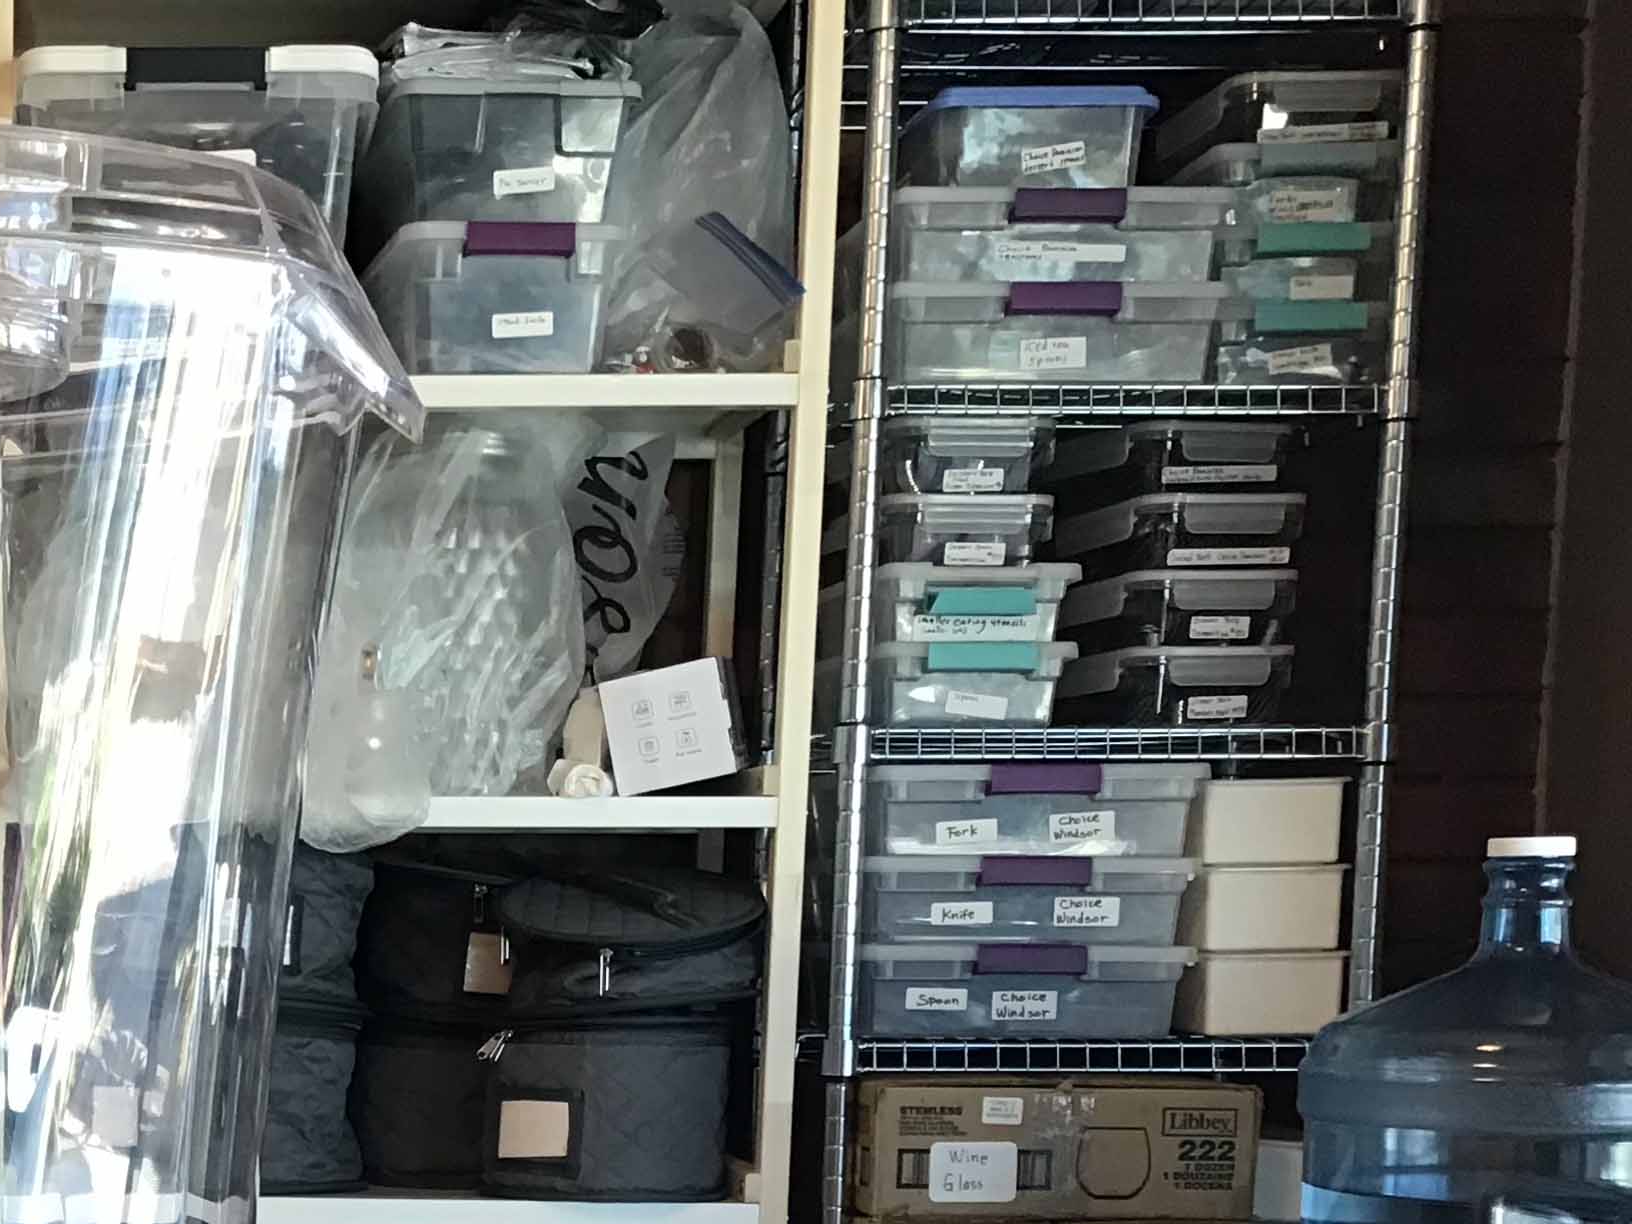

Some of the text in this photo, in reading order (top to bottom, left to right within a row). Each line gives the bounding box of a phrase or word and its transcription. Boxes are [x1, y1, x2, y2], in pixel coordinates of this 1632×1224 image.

[1057, 813, 1101, 826] Choice
[945, 824, 979, 840] Fork
[1053, 827, 1103, 841] Windsor
[1059, 898, 1103, 910] Choice
[942, 908, 976, 923] Knife
[1056, 911, 1109, 925] Windsor
[916, 993, 960, 1009] Spoon
[1000, 993, 1047, 1003] Choice
[996, 1005, 1051, 1019] Windsor
[1169, 1111, 1233, 1134] Libbey
[948, 1147, 990, 1166] Wine
[1178, 1140, 1236, 1162] 222
[943, 1172, 985, 1192] Glass
